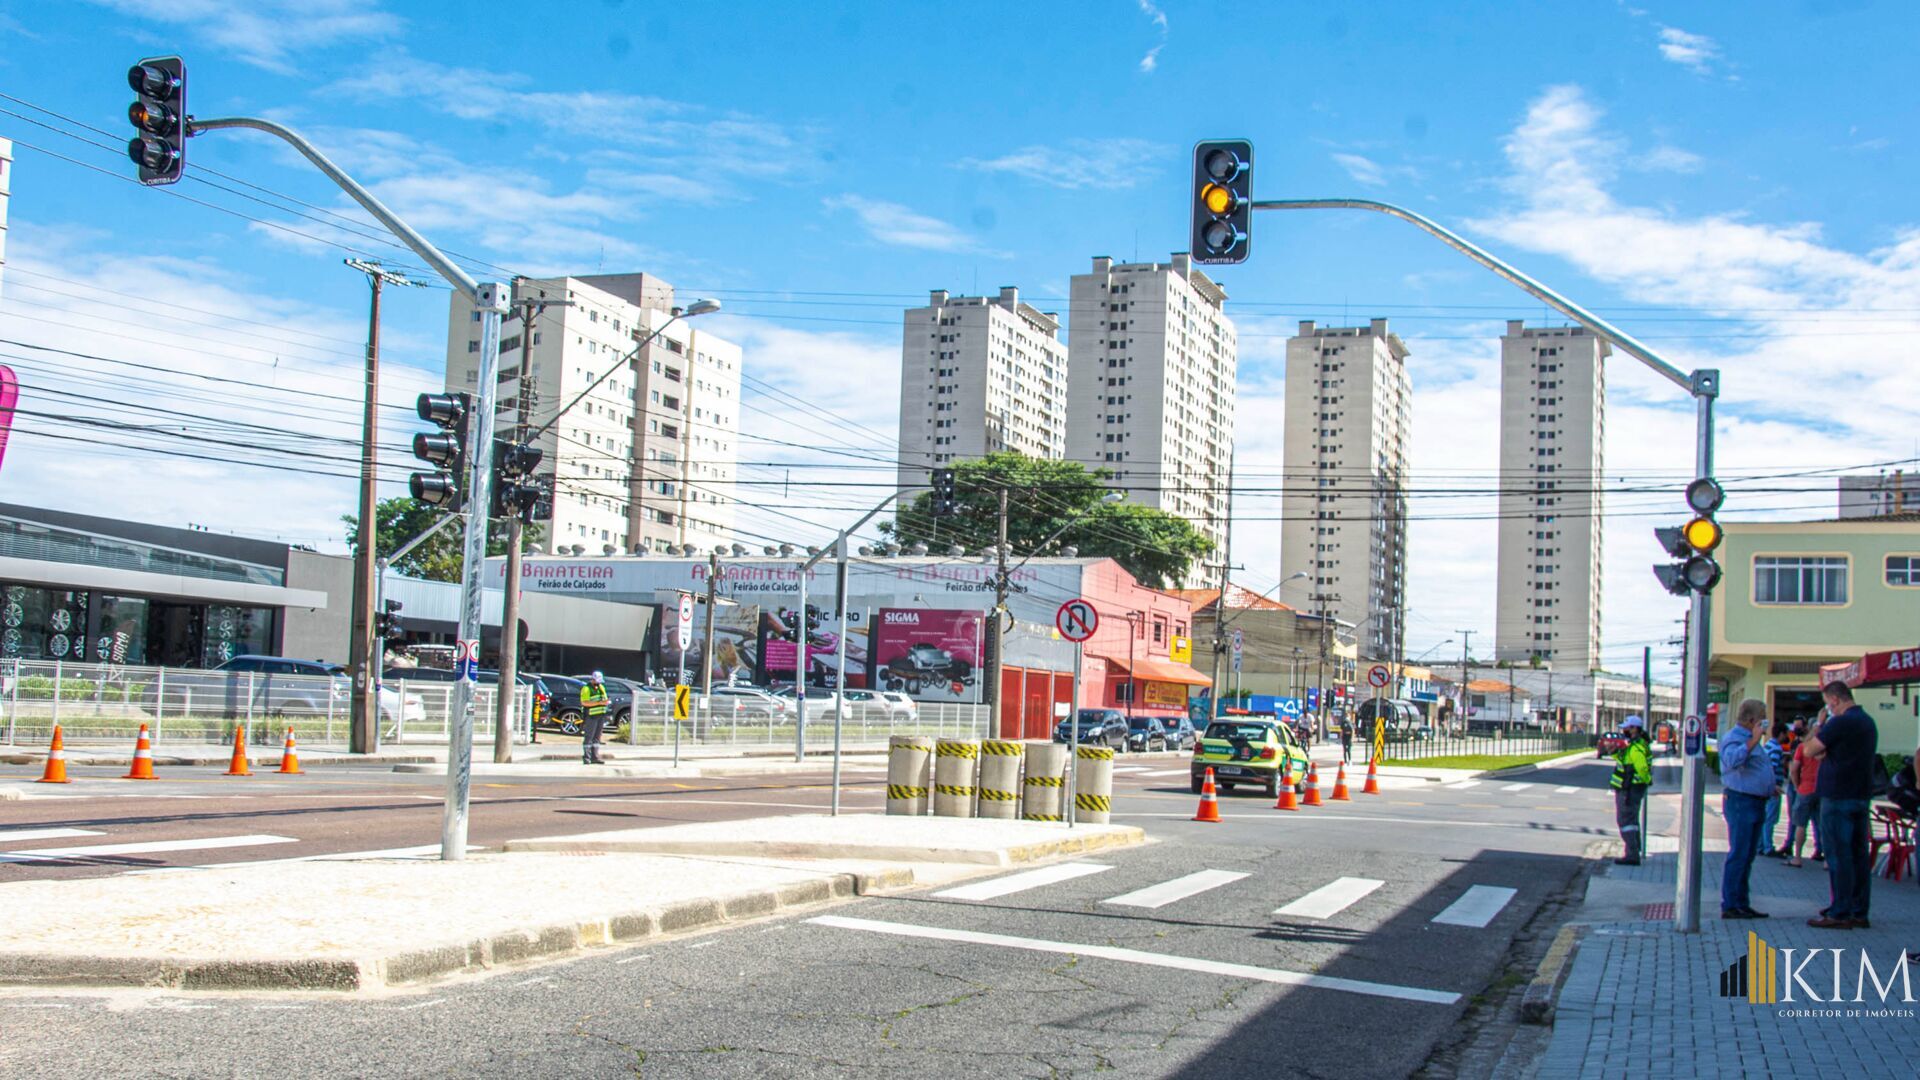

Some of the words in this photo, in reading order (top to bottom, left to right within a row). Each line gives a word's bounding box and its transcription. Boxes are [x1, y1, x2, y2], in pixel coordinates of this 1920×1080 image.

[522, 563, 614, 578] BARATEIRA
[692, 564, 705, 579] A
[538, 580, 562, 588] Feirão
[563, 580, 572, 588] de
[573, 580, 606, 590] Calçados
[733, 582, 759, 591] Feirão
[760, 582, 770, 591] de
[946, 582, 974, 592] Feirão
[975, 582, 986, 591] de
[884, 612, 920, 622] SIGMA
[112, 631, 130, 663] SIGMA
